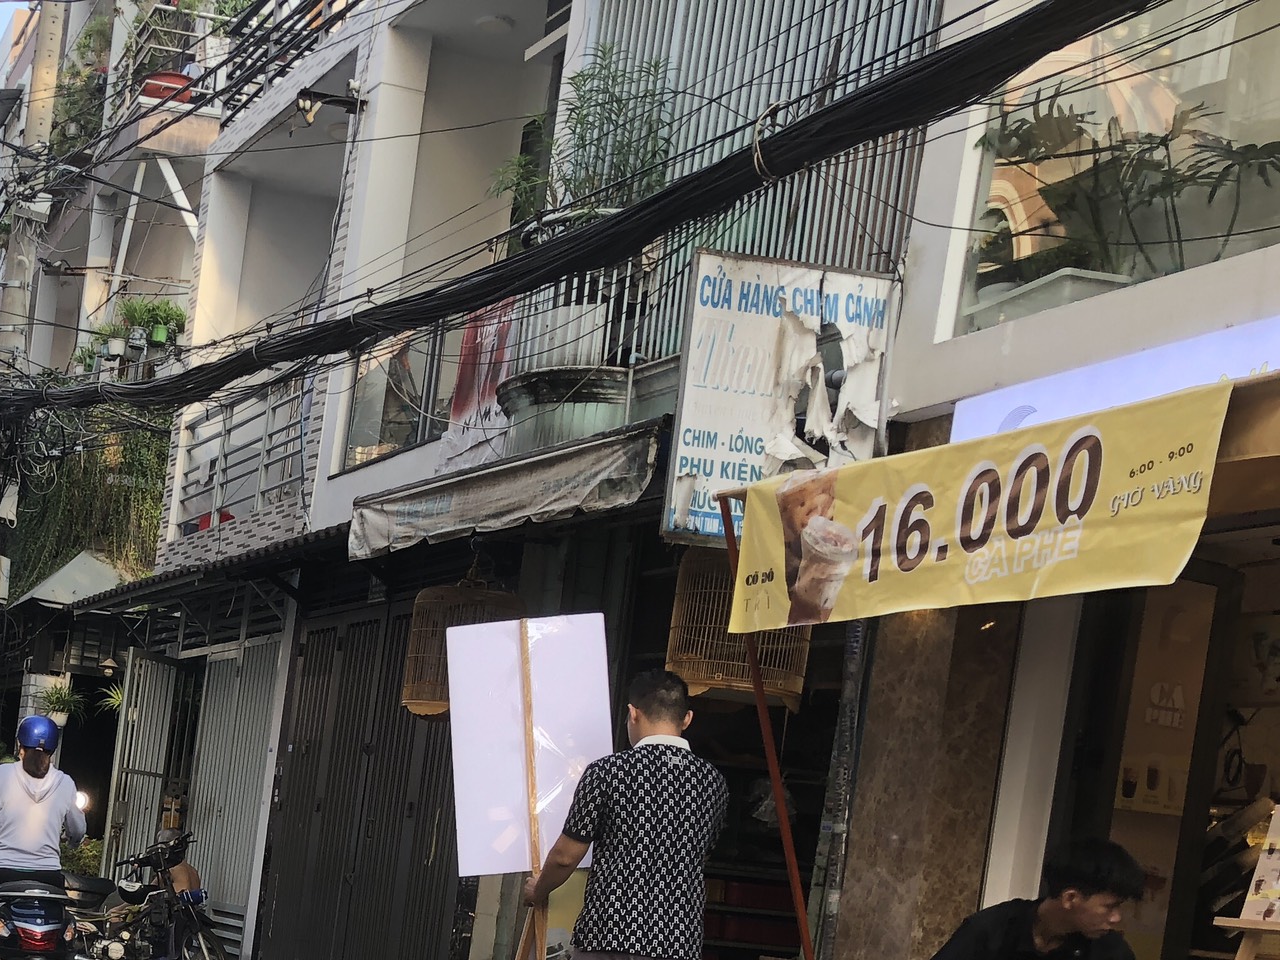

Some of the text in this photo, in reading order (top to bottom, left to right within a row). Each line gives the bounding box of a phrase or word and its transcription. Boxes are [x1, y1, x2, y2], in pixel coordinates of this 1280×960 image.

[700, 265, 887, 329] CỬA HÀNG CHIM CẢNH
[682, 428, 718, 450] CHIM
[679, 456, 762, 486] PHỤ KIỆN
[1129, 460, 1154, 478] 6:00
[1168, 443, 1194, 461] 9:00
[858, 430, 1103, 584] 16.000
[1110, 470, 1203, 517] GIỜ VÀNG
